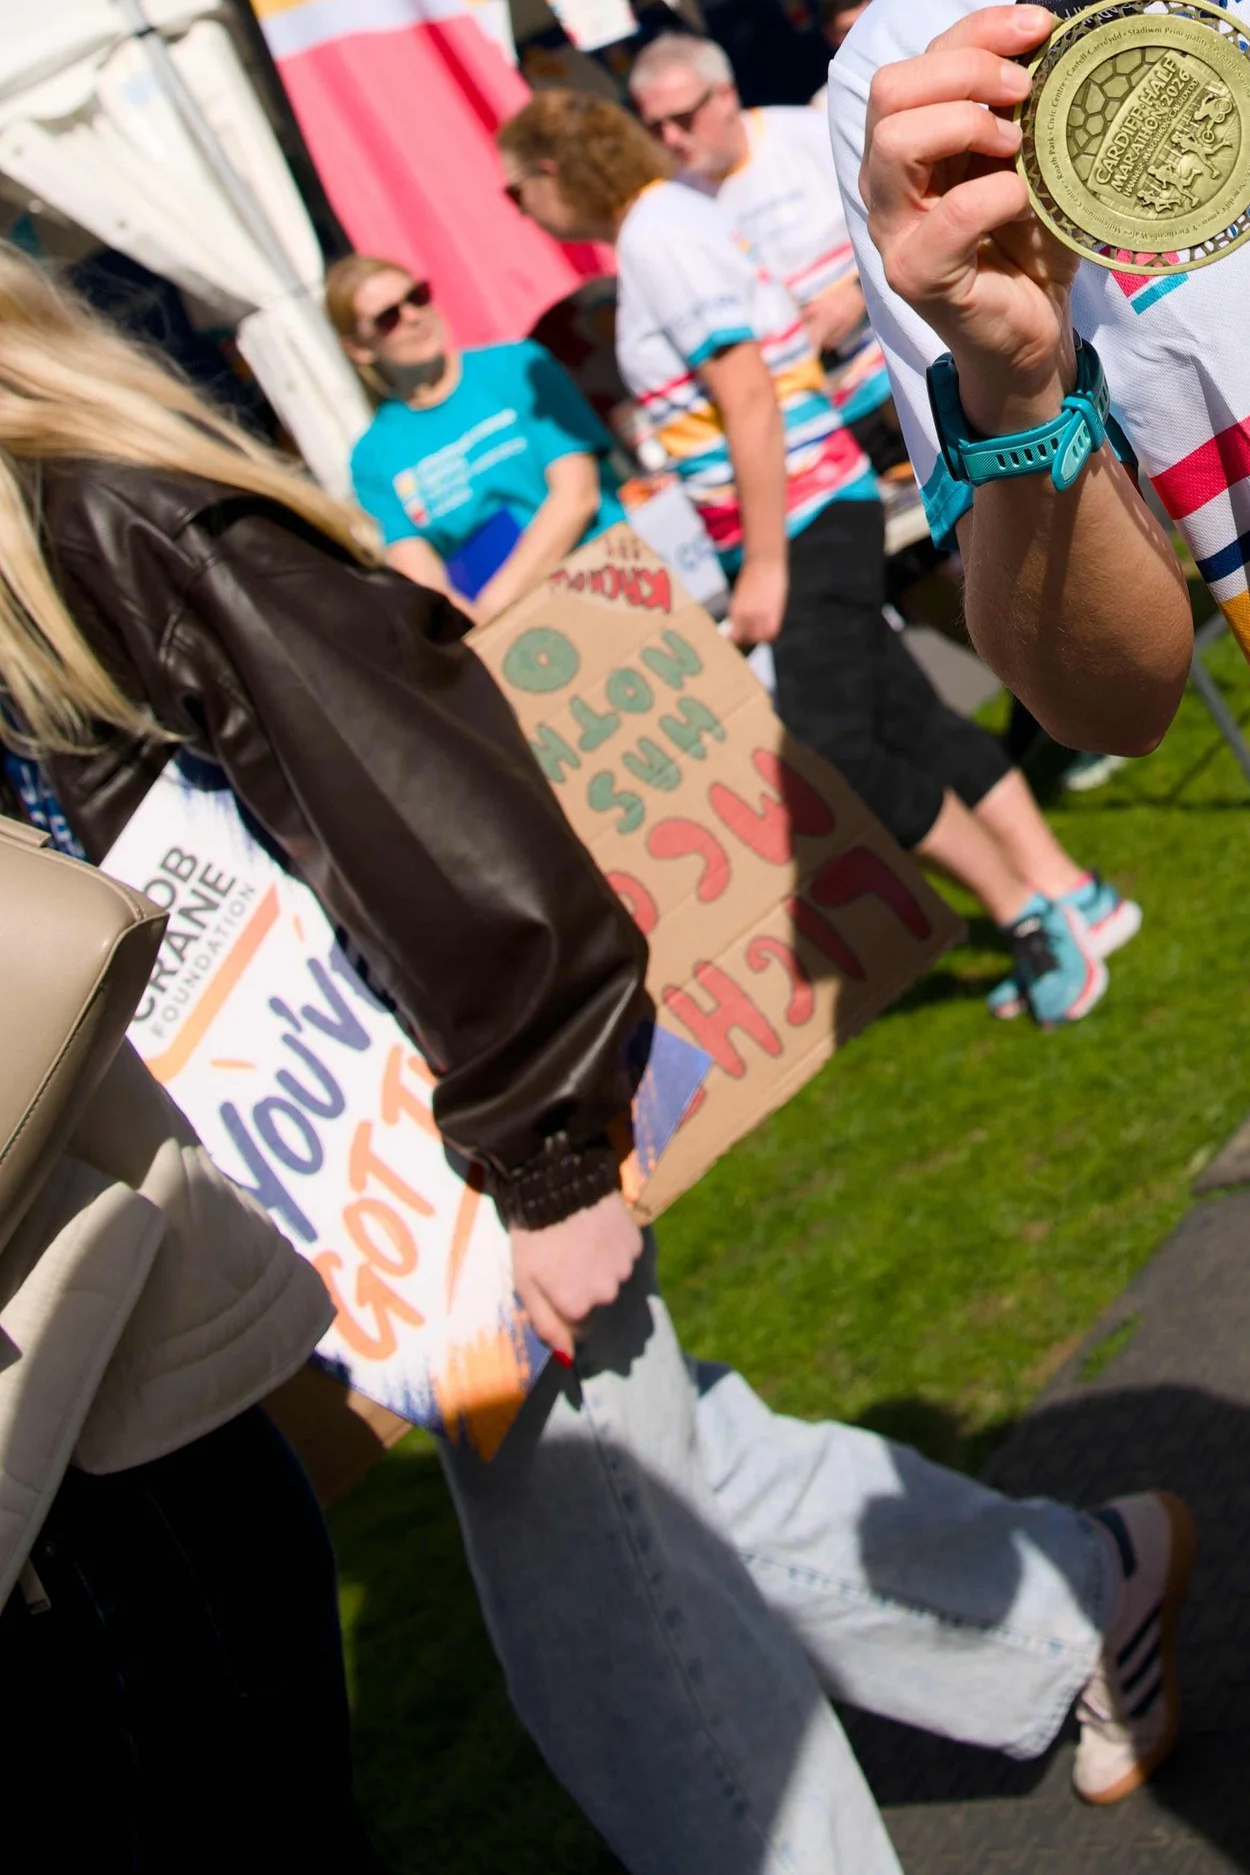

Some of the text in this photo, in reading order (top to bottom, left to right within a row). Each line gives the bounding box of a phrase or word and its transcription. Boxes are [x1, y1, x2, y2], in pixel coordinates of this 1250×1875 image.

[1046, 136, 1057, 155] Park
[1050, 80, 1067, 108] Centre
[530, 629, 704, 785] NOTH
[587, 696, 726, 835] HAS
[143, 844, 199, 910] OB
[150, 883, 256, 1041] FOUNDATION
[662, 844, 933, 1090] LIGH
[219, 956, 372, 1244] YOU'V
[313, 1120, 437, 1363] GOT
